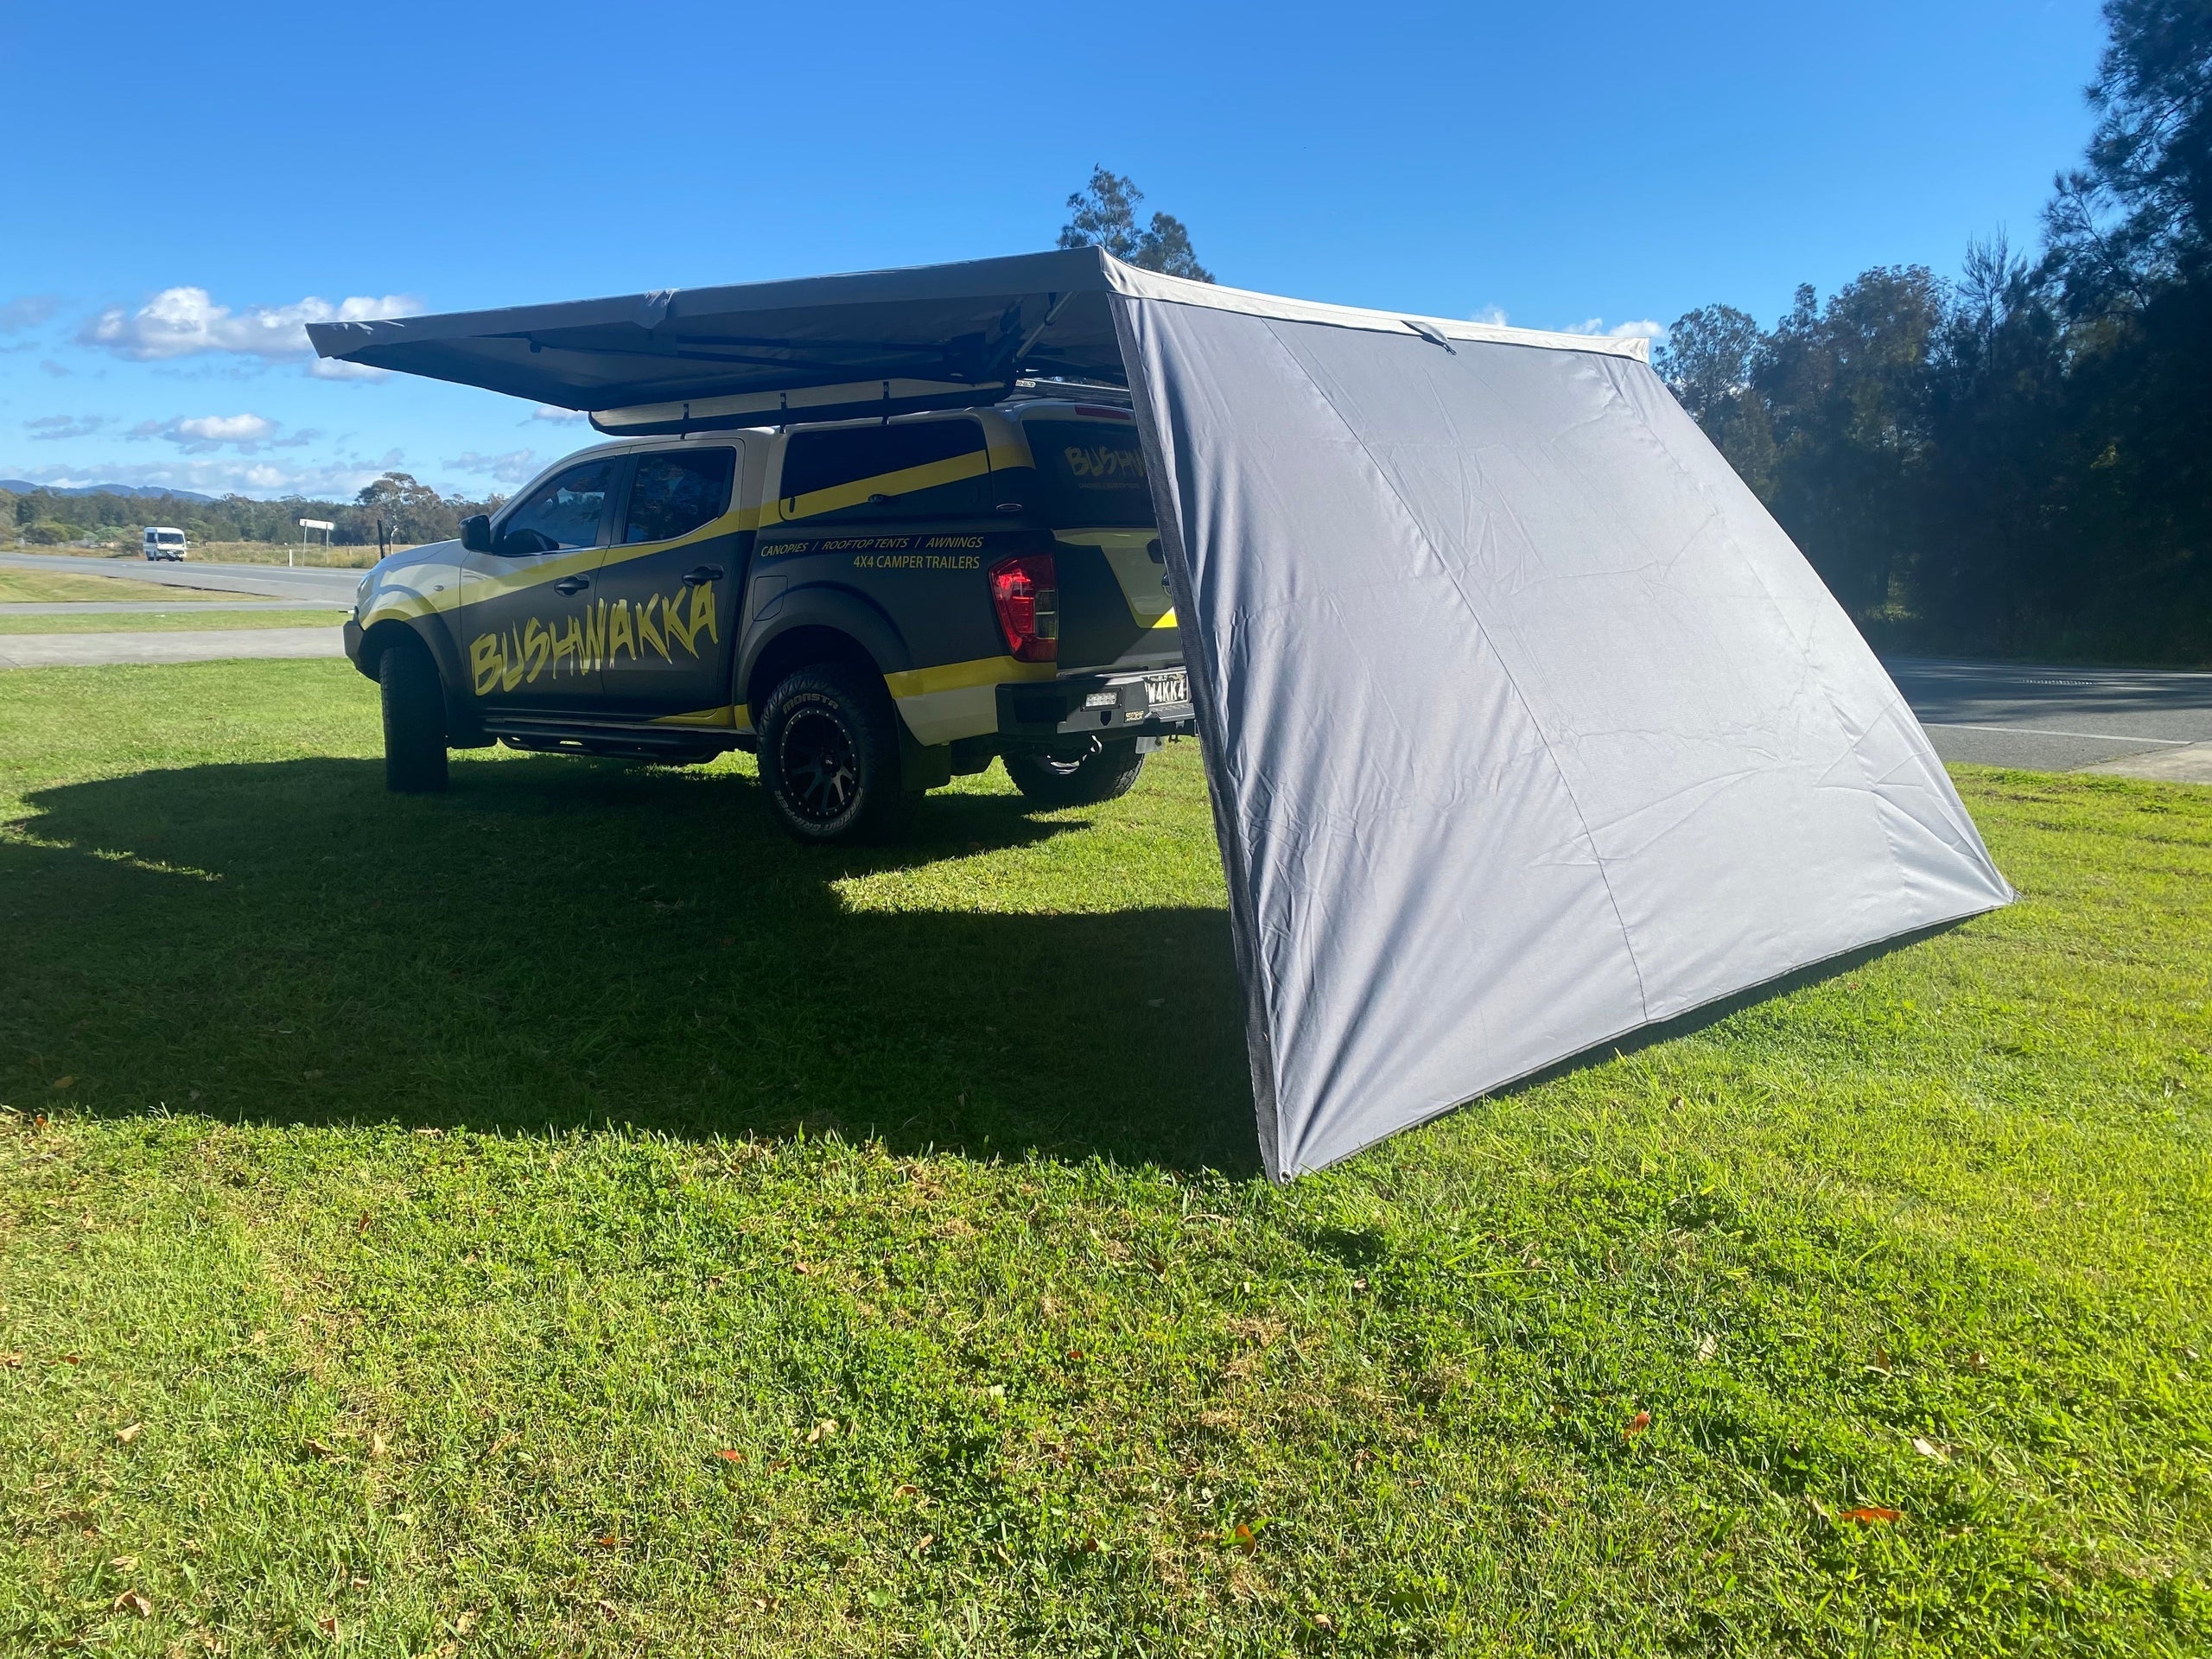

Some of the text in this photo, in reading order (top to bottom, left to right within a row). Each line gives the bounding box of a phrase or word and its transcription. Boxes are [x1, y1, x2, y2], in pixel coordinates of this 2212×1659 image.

[761, 543, 809, 556] CANOPIES
[822, 539, 874, 550] ROOFTOP
[874, 537, 910, 548] TENTS
[925, 537, 984, 548] AWNINGS
[853, 556, 981, 569] 4X4 CAMPER TRAILERS
[470, 581, 718, 696] BUSHWAKKA
[1145, 679, 1184, 703] W4KK4
